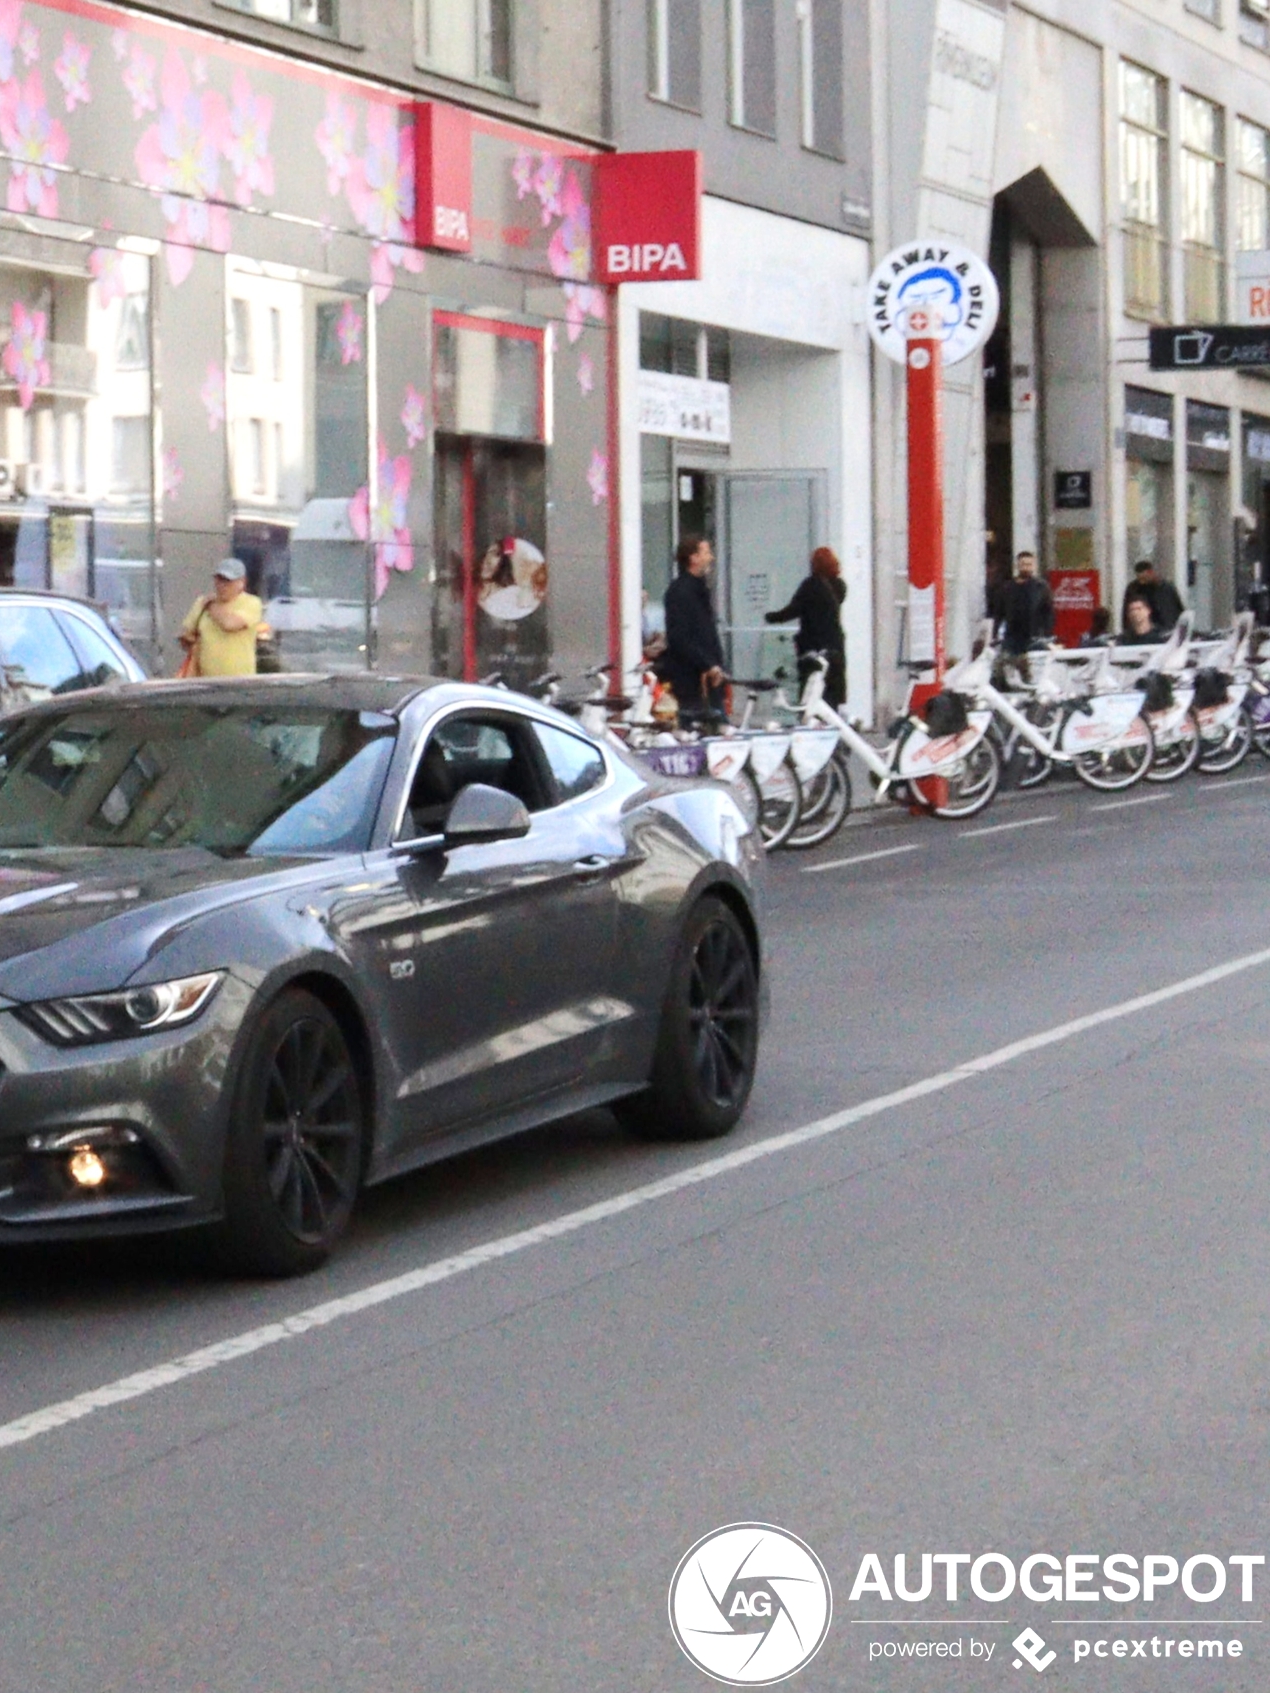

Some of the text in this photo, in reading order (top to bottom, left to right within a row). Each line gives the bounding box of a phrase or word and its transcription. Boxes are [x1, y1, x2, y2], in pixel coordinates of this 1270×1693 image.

[434, 206, 469, 242] BIPA
[607, 243, 686, 273] BIPA
[874, 280, 891, 334] TAKE
[891, 248, 949, 275] AWAY
[964, 284, 983, 330] DELI
